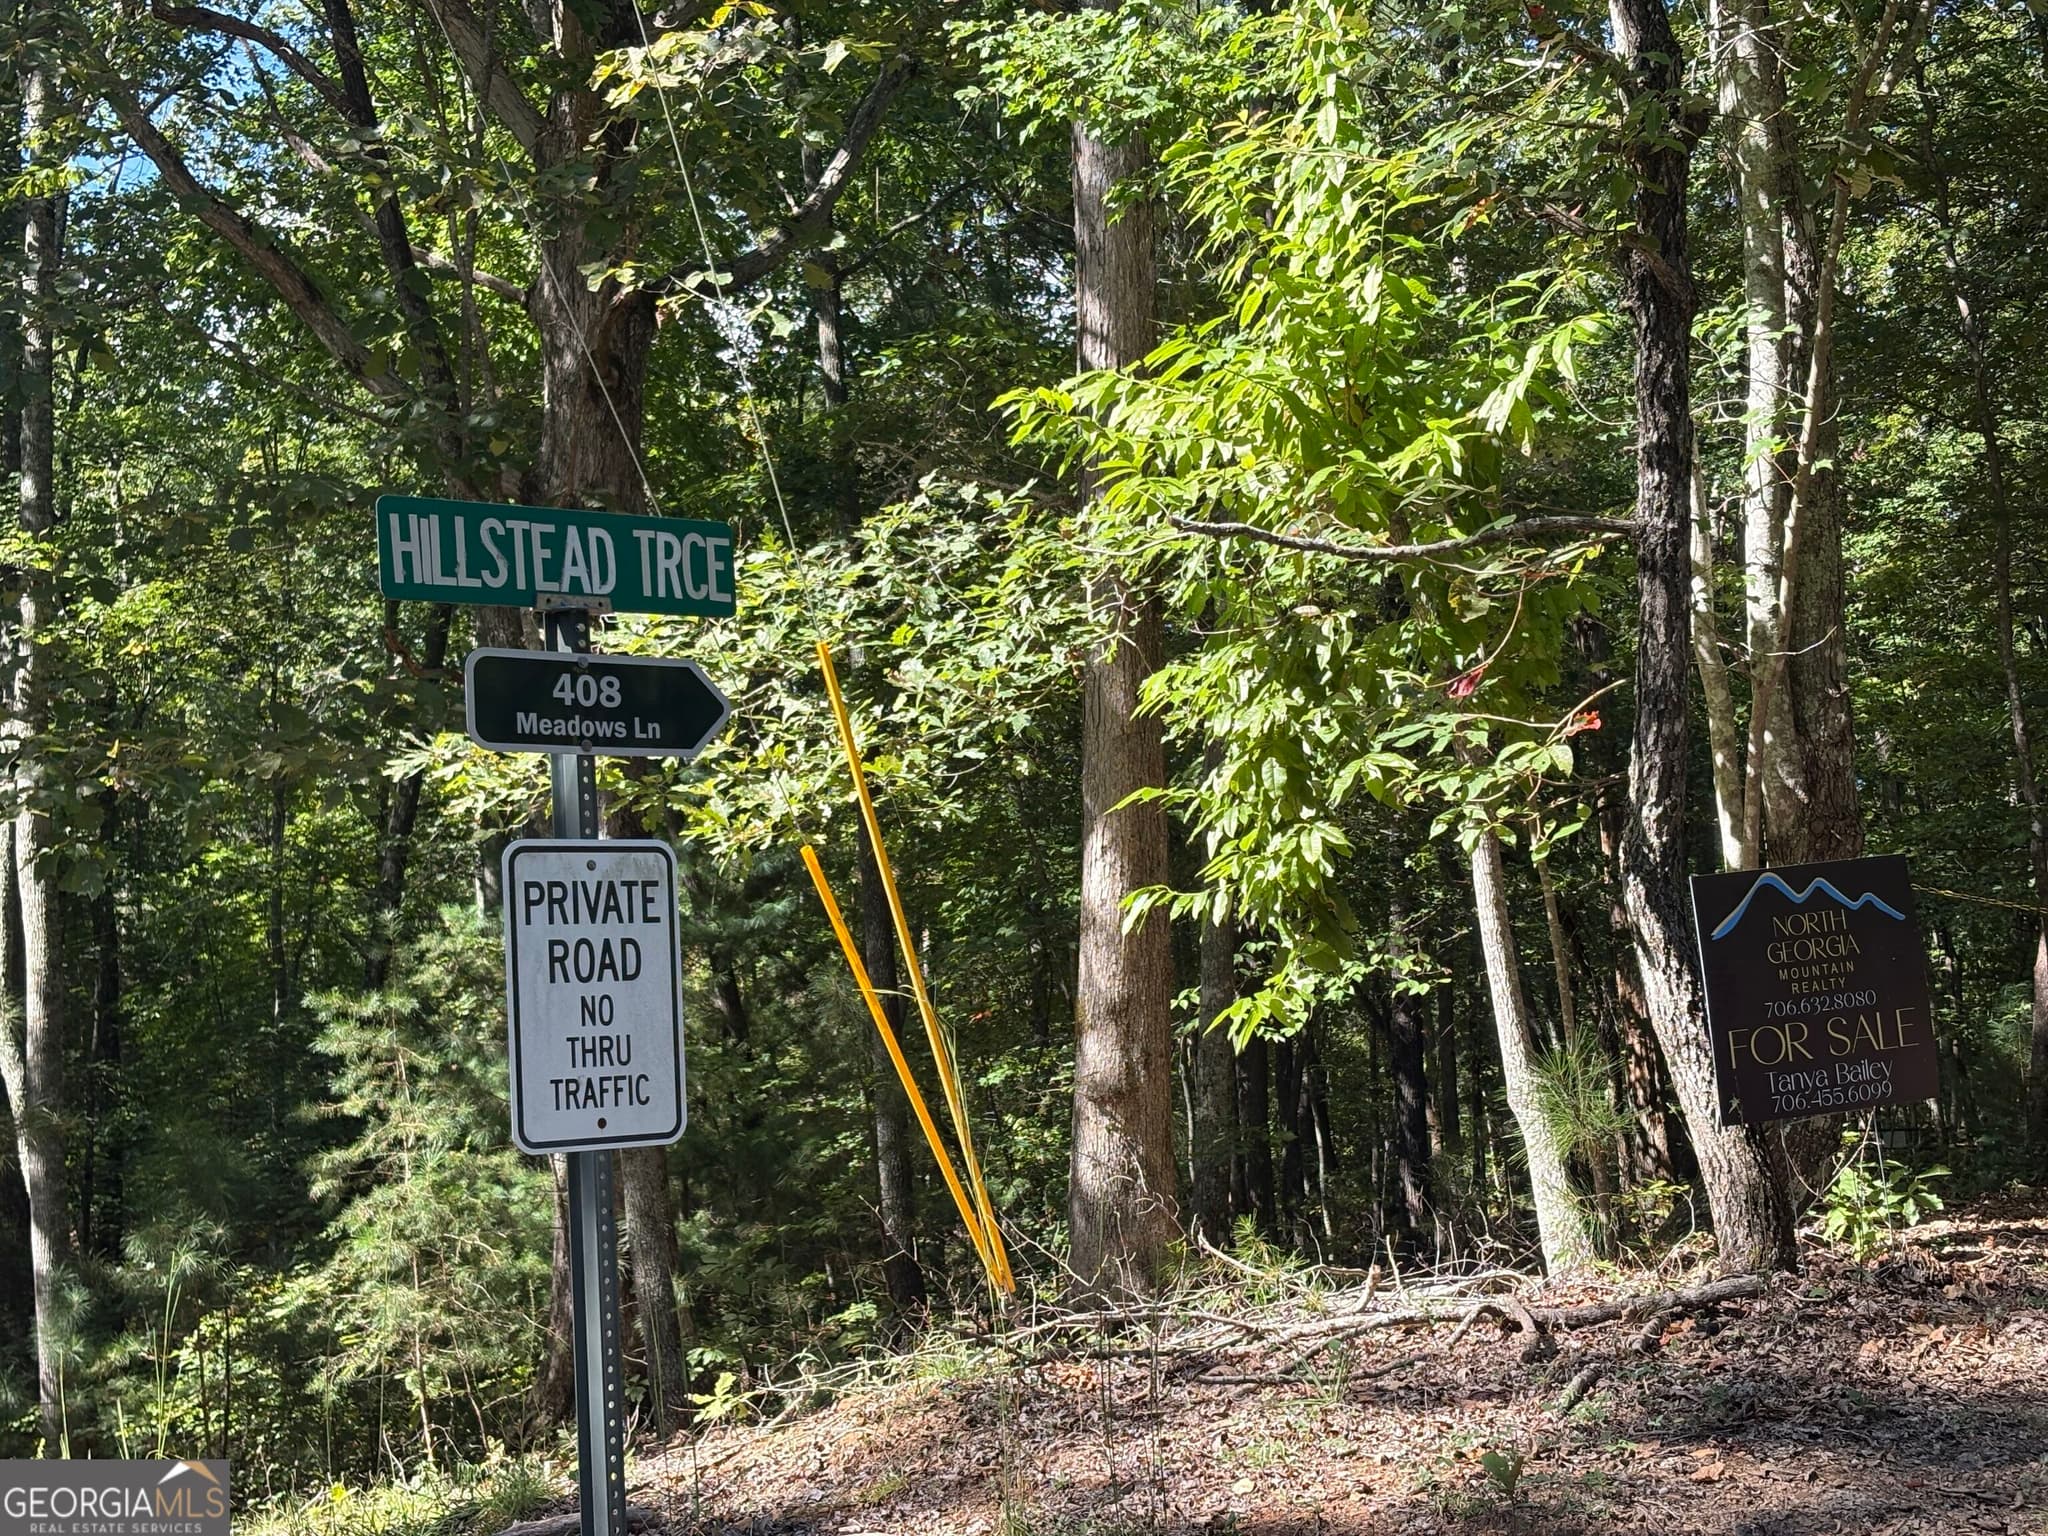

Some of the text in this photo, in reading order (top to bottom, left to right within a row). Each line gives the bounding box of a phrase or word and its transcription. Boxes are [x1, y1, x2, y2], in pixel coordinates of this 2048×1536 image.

[389, 513, 732, 602] HILLSTEAD TRCE
[552, 673, 622, 708] 408
[516, 712, 661, 739] Meadows Ln
[523, 880, 661, 926] PRIVATE
[1772, 909, 1847, 937] NORTH
[548, 938, 642, 984] ROAD
[1767, 934, 1861, 964] GEORGIA
[1779, 961, 1855, 980] MOUNTAIN
[1791, 977, 1847, 994] REALTY
[581, 994, 614, 1027] NO
[1764, 990, 1877, 1018] 706.632.8080
[566, 1034, 632, 1068] THRU
[1728, 1007, 1920, 1069] FOR SALE
[550, 1074, 650, 1111] TRAFFIC
[1765, 1058, 1893, 1096] Tanya Bailey
[1771, 1080, 1893, 1113] 706.455.6099
